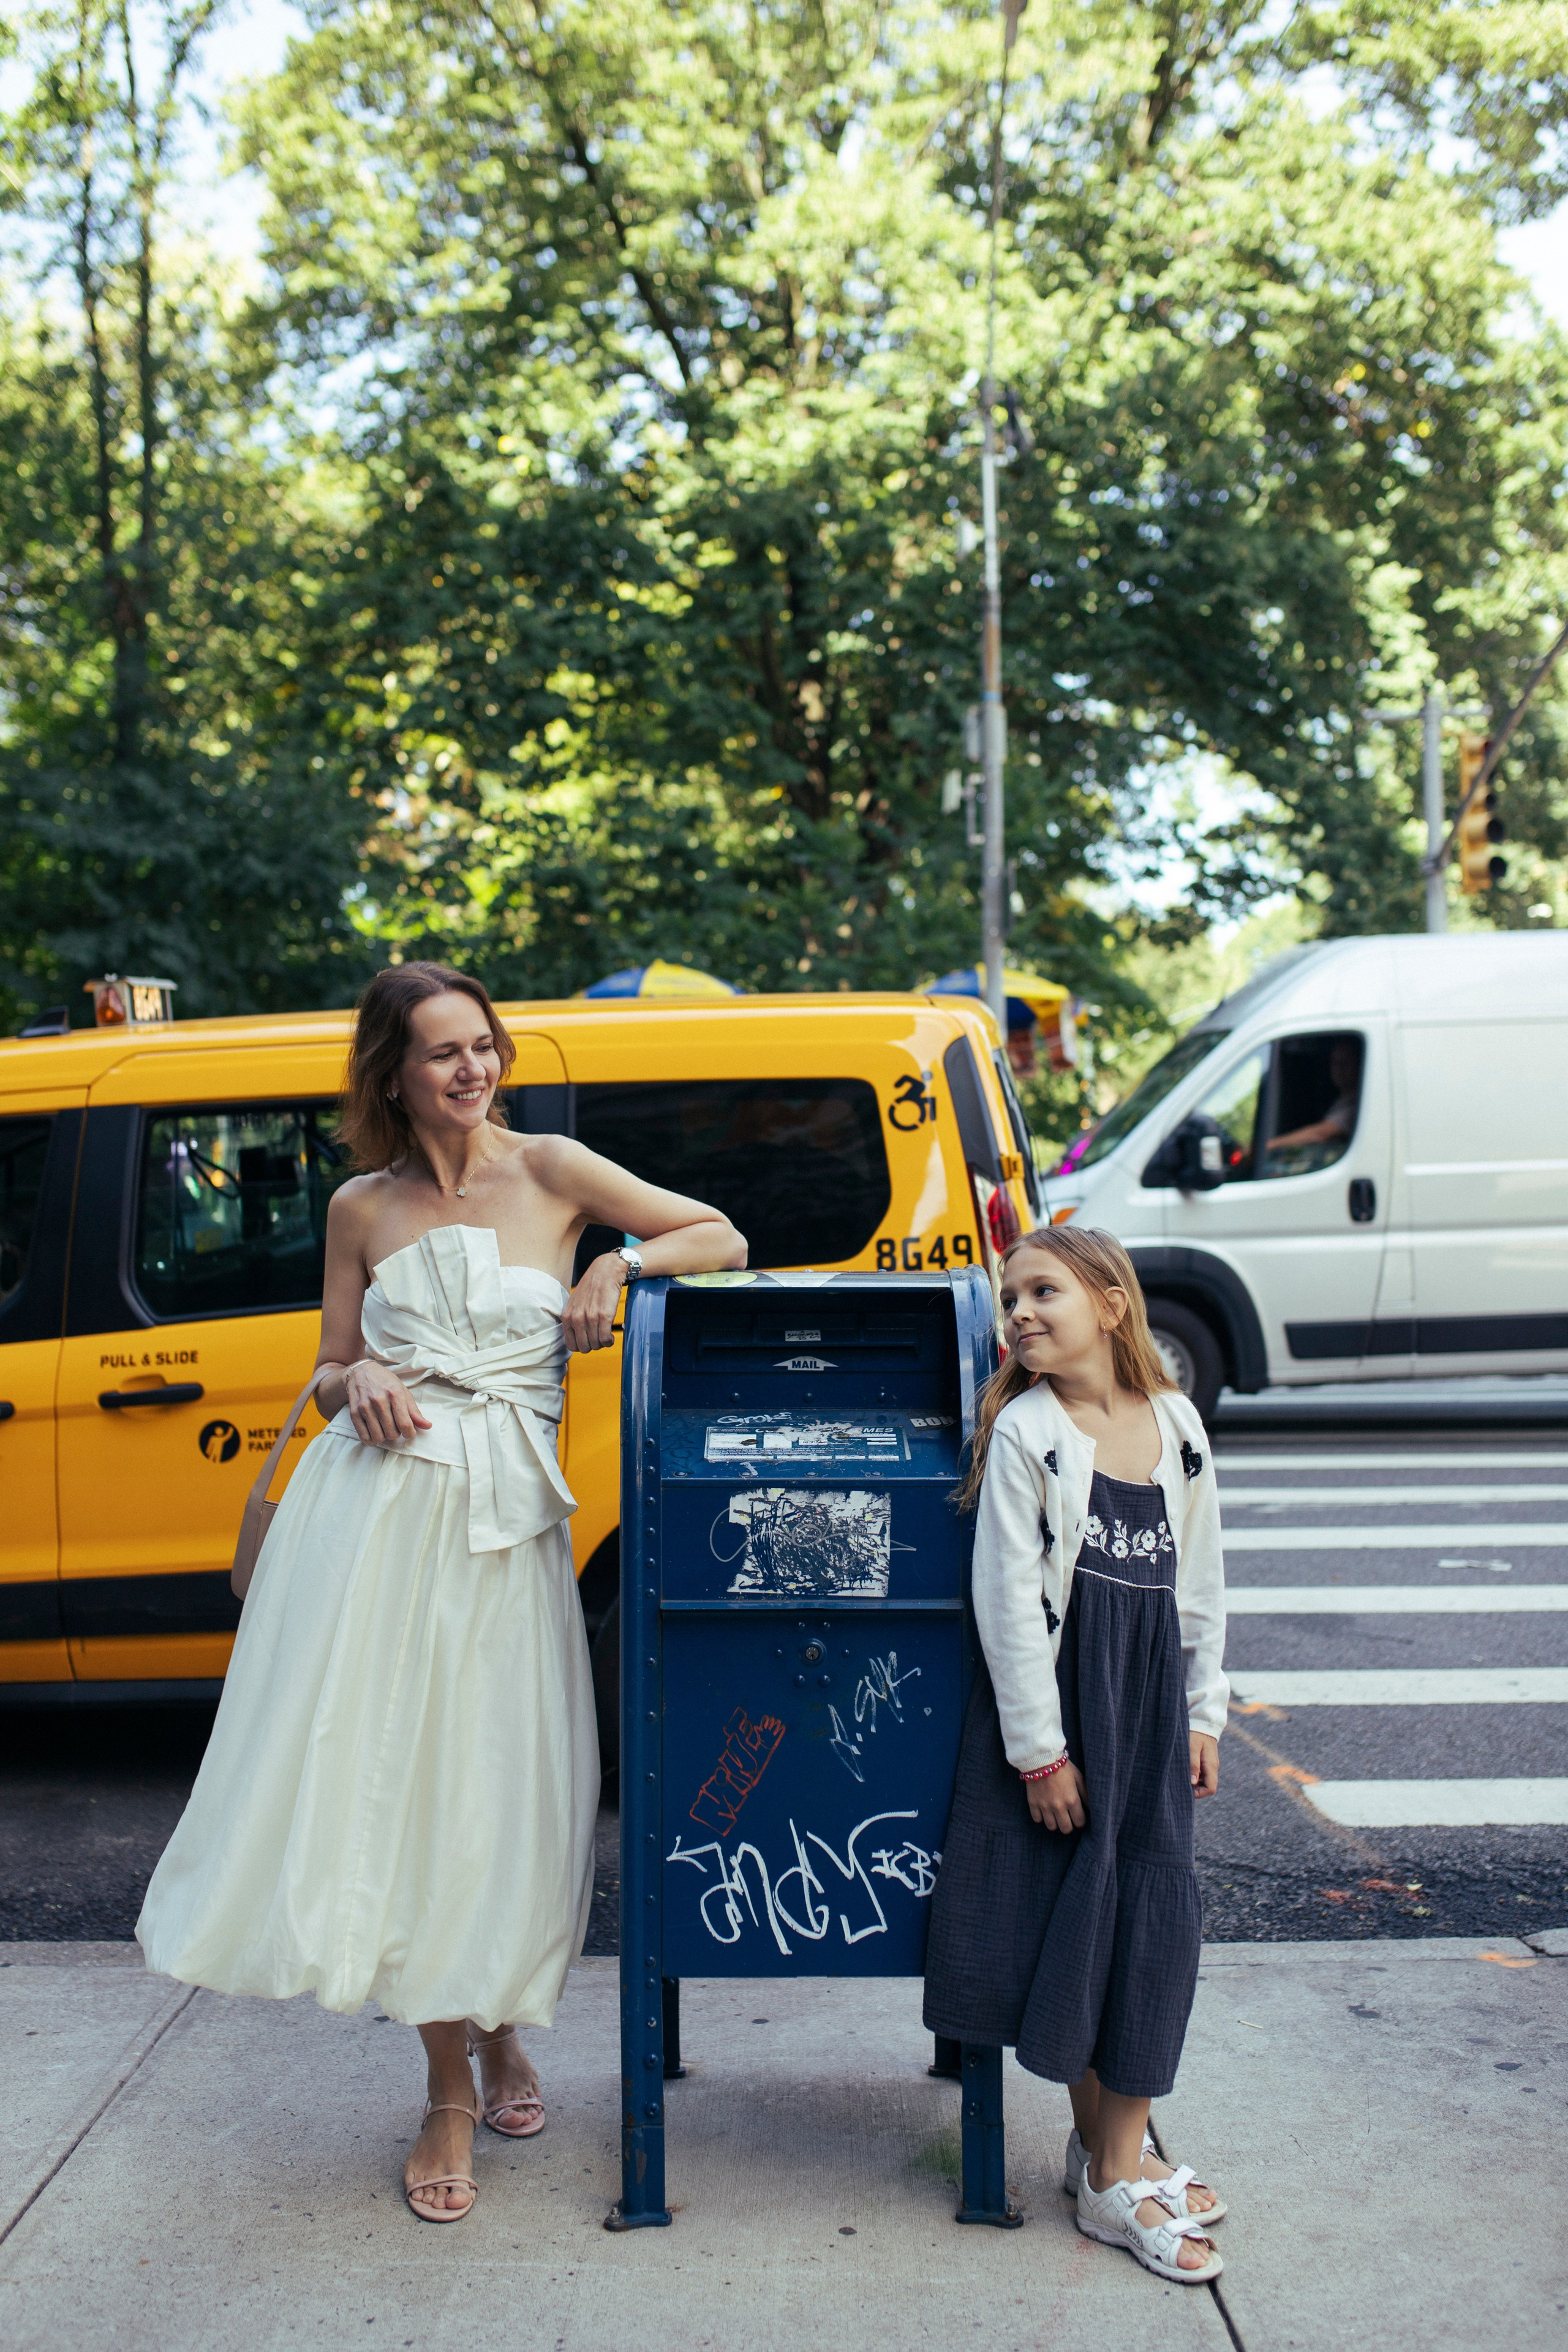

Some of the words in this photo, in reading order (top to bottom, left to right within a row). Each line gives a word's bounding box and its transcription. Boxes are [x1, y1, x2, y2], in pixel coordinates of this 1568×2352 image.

[876, 1235, 973, 1272] 8G49
[100, 1354, 137, 1368] PULL
[141, 1352, 151, 1366] &
[156, 1350, 199, 1365] SLIDE
[792, 1360, 820, 1369] MAIL
